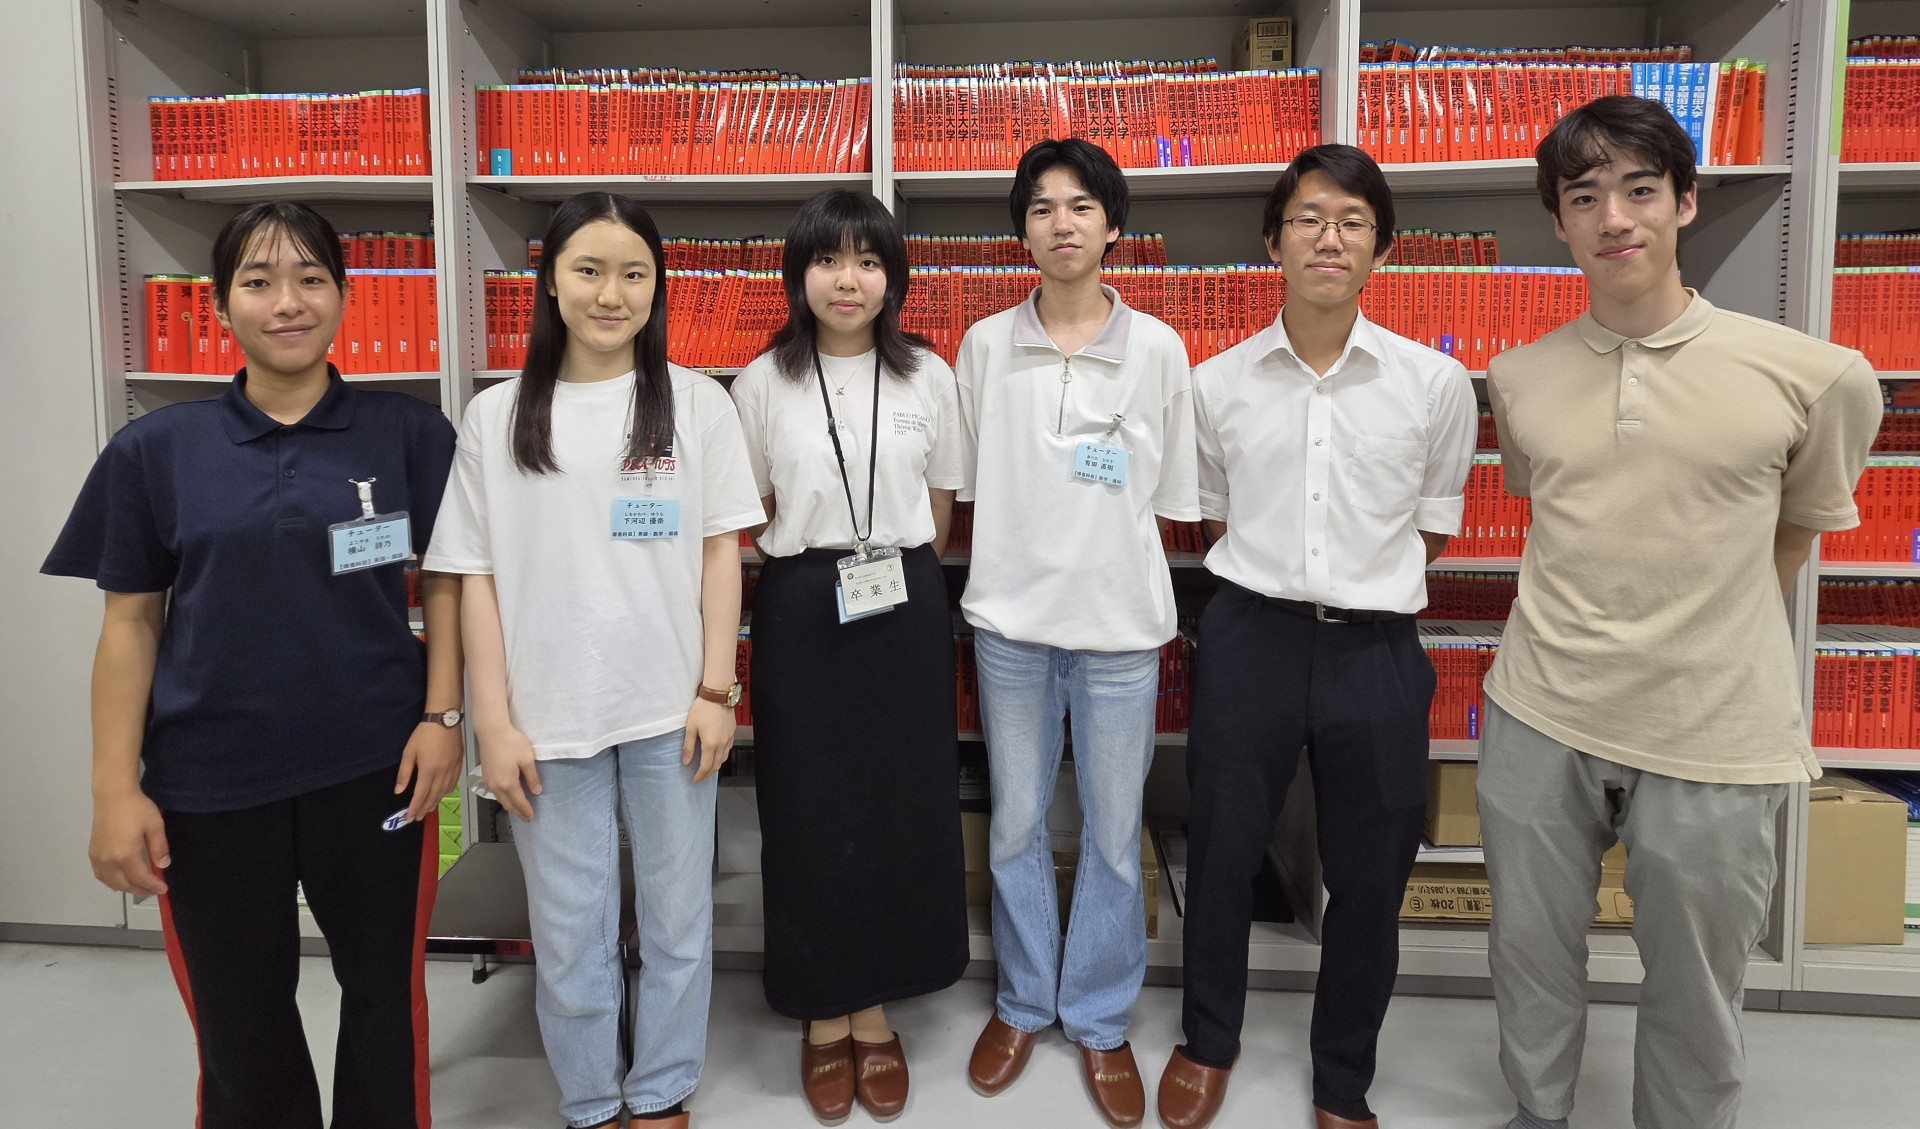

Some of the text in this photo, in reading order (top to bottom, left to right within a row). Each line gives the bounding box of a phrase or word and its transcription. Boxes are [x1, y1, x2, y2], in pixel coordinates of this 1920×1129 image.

[958, 89, 969, 141] 岩手大学
[1087, 87, 1100, 140] 群馬大学
[1101, 87, 1114, 139] 群馬大学
[1115, 87, 1129, 139] 群馬大学
[1308, 79, 1320, 117] 富山大学
[1677, 86, 1690, 117] 早稲田大学
[1691, 86, 1705, 118] 早稲田大学
[156, 285, 168, 322] 東京大学
[198, 286, 210, 323] 東京大学
[486, 282, 497, 318] 一橋大学
[509, 282, 519, 319] 一橋大学
[523, 282, 533, 318] 一橋大学
[1191, 277, 1200, 331] 京都府立大学
[1218, 277, 1227, 331] 奈良女子大学
[1389, 274, 1399, 312] 早稲田大学
[1402, 274, 1412, 312] 早稲田大学
[1417, 274, 1427, 312] 早稲田大学
[1459, 274, 1470, 312] 早稲田大学
[1478, 274, 1489, 312] 早稲田大学
[1519, 274, 1530, 313] 早稲田大学
[1086, 445, 1117, 455] チューター
[348, 525, 390, 537] チューター
[624, 517, 645, 525] 下河辺
[348, 545, 366, 555] 横山
